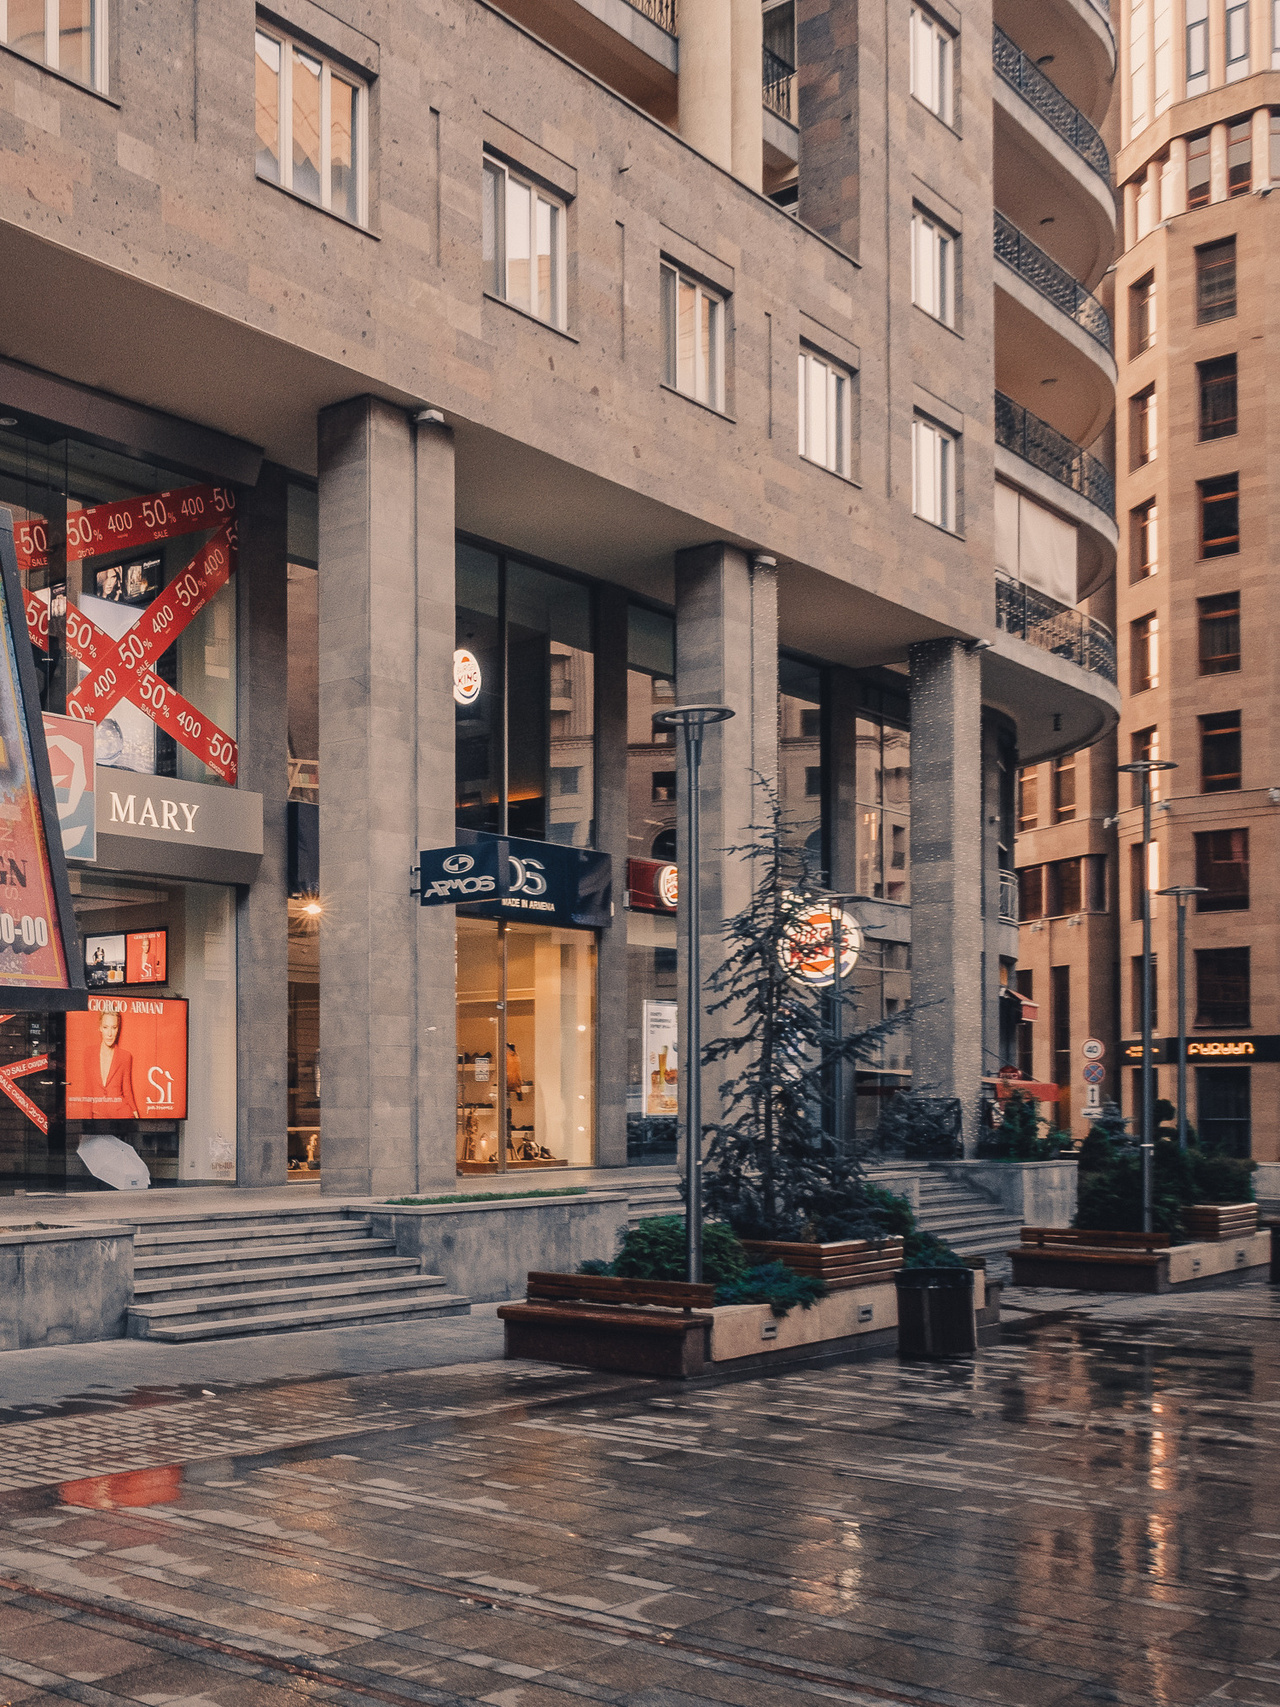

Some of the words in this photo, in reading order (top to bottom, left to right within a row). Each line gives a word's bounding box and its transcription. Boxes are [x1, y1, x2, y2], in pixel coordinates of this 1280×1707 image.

[107, 511, 133, 533] 400
[181, 496, 205, 516] 400
[153, 529, 169, 540] SALE
[31, 557, 48, 567] SALE
[93, 667, 118, 699] 400
[151, 604, 174, 634] 400
[203, 548, 225, 577] 400
[28, 630, 44, 647] SALE
[136, 659, 151, 677] SALE
[140, 703, 157, 720] SALE
[176, 711, 202, 739] 400
[109, 791, 200, 833] MARY
[424, 875, 496, 898] ARMOS
[501, 898, 521, 908] MADE
[521, 899, 529, 909] IN
[529, 901, 556, 912] ARMENIA
[88, 998, 128, 1013] GIORGIO
[130, 1001, 164, 1015] ARMANI
[1086, 1045, 1099, 1053] 40
[11, 1064, 28, 1075] SALE
